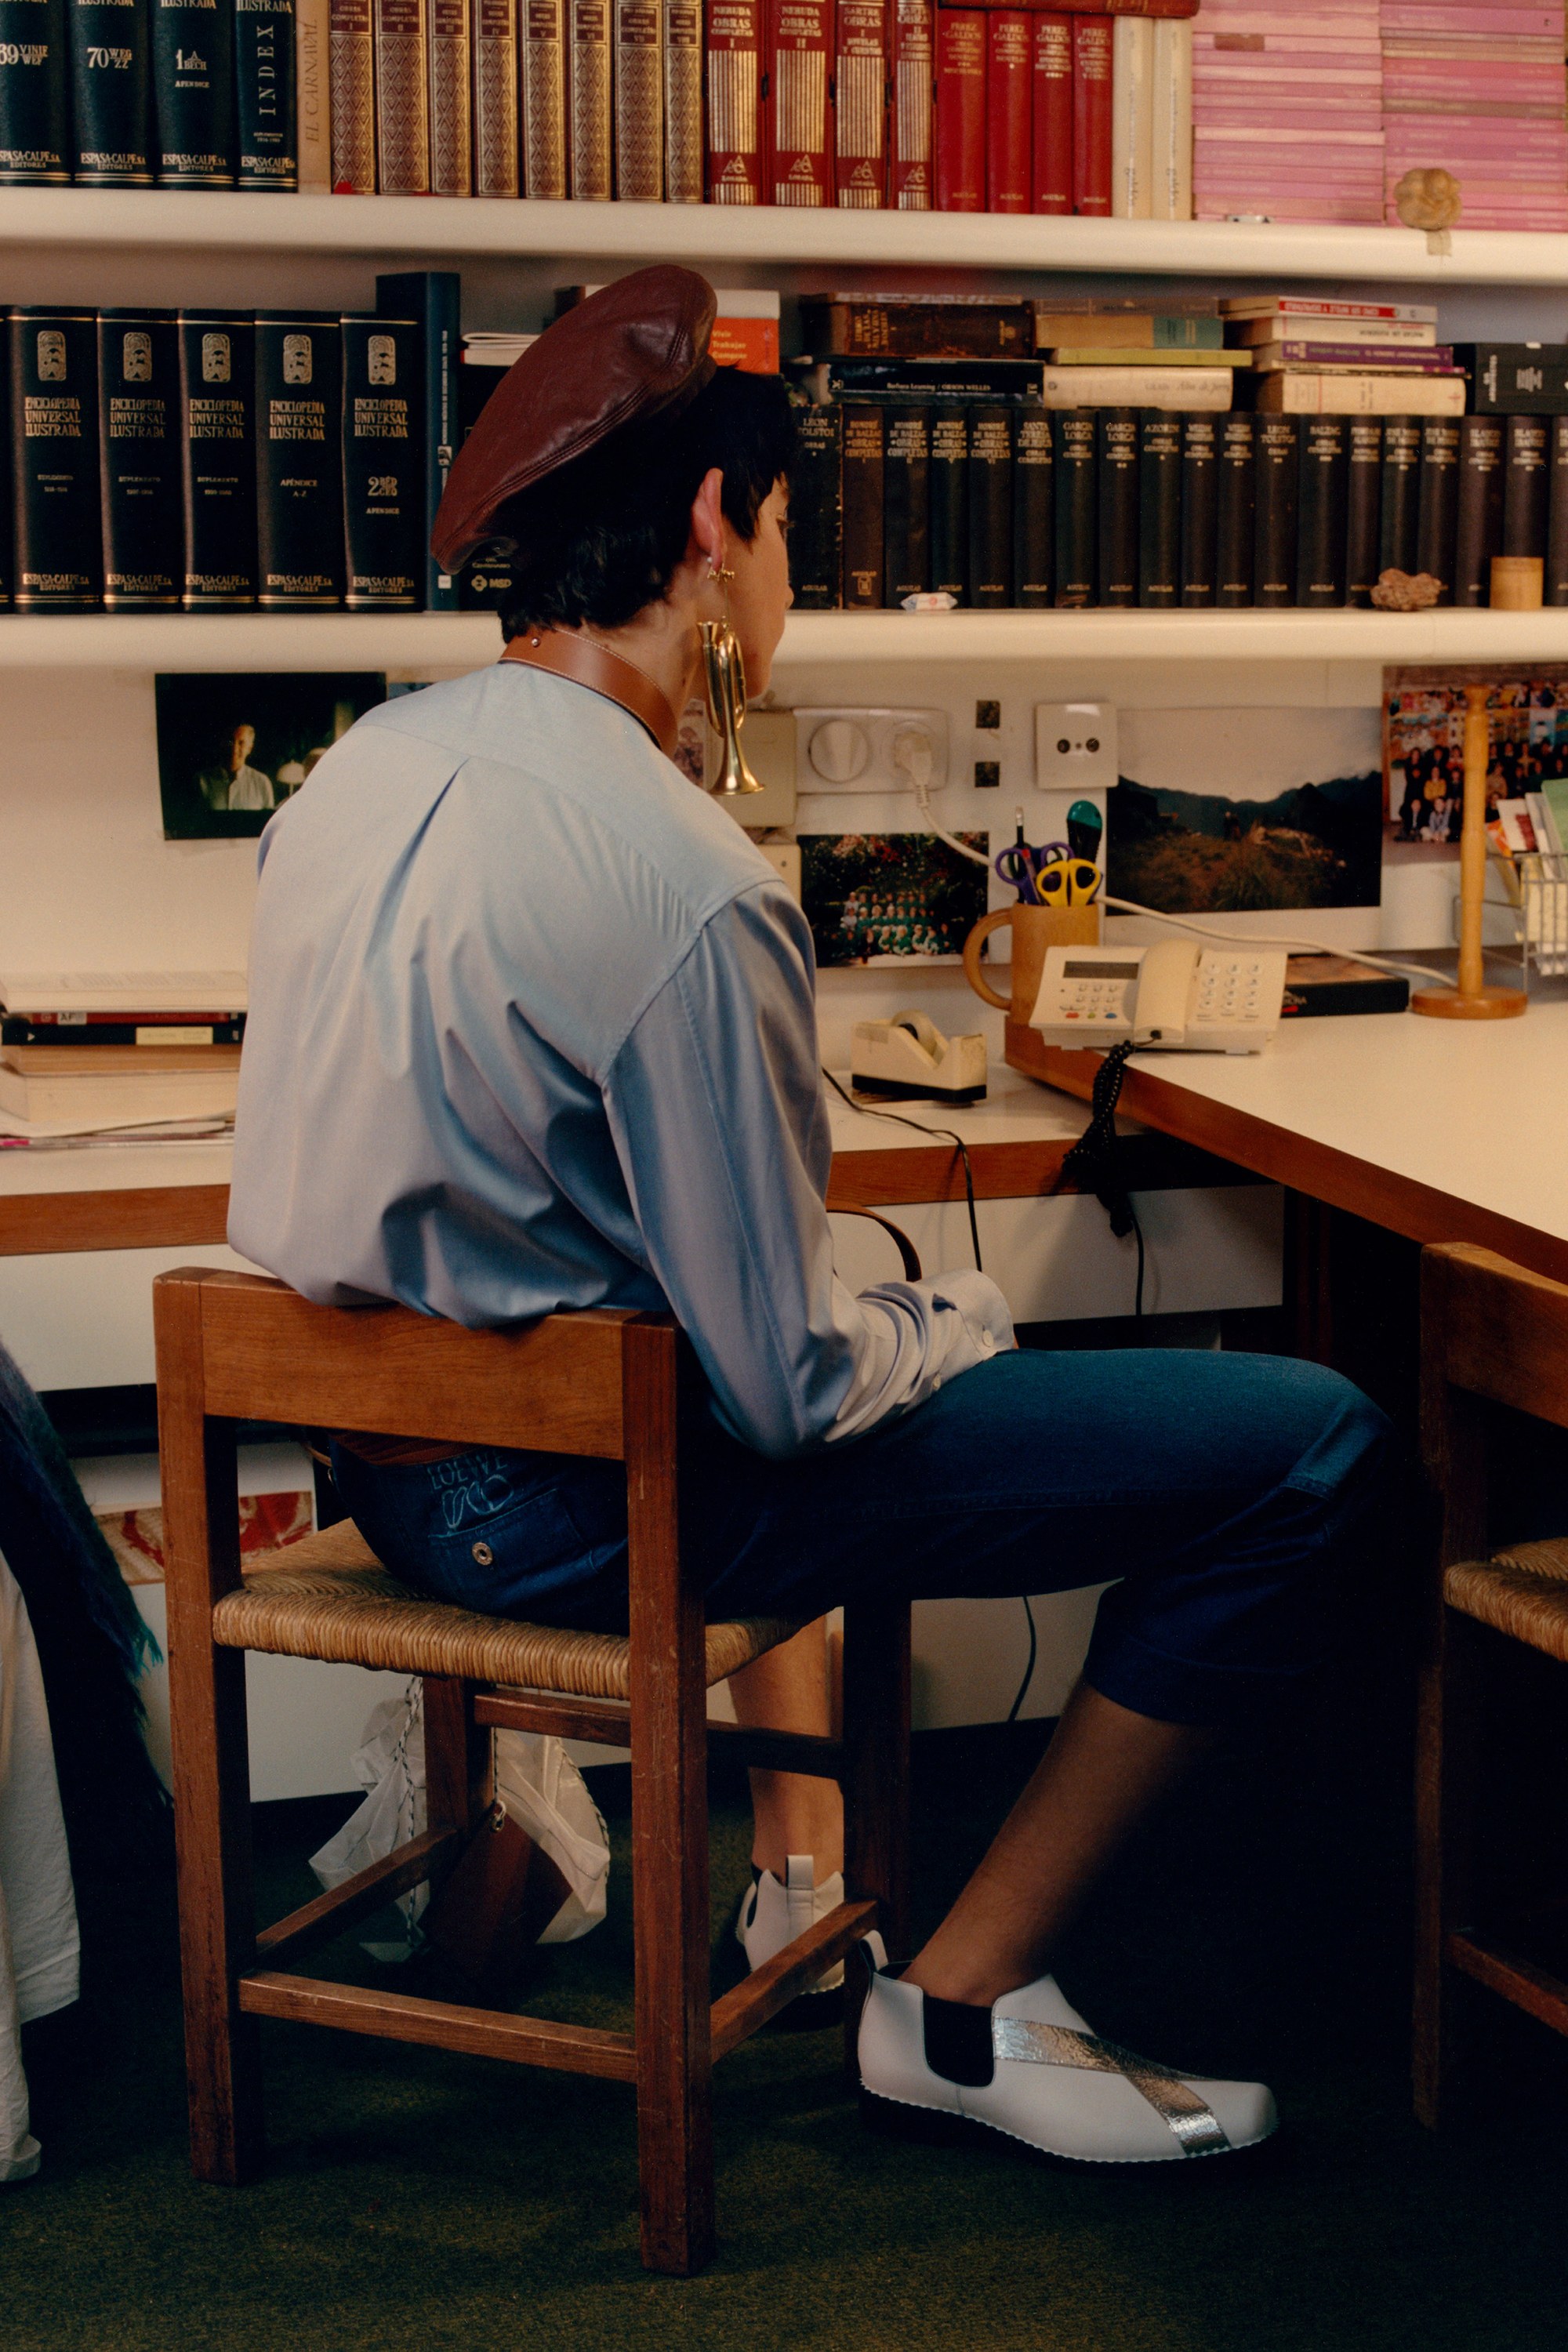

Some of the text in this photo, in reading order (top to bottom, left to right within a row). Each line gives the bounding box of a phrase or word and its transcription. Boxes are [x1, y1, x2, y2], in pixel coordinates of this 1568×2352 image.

[713, 5, 752, 16] NERUDA
[782, 5, 820, 16] NERUDA
[713, 17, 752, 28] OBRAS
[781, 17, 820, 28] OBRAS
[844, 16, 882, 27] OBRAS
[729, 38, 735, 49] I
[796, 38, 806, 49] II
[87, 47, 110, 68] 70
[114, 59, 129, 69] ZZ
[176, 49, 183, 70] 1
[256, 24, 276, 116] INDEX
[305, 122, 319, 143] EL
[25, 396, 81, 410] ENCICLOPEDIA
[111, 397, 165, 412] ENCICLOPEDIA
[190, 398, 245, 412] ENCICLOPEDIA
[270, 399, 325, 414] ENCICLOPEDIA
[354, 397, 408, 412] ENCICLOPEDIA
[25, 409, 81, 423] UNIVERSAL
[111, 412, 166, 425] UNIVERSAL
[190, 412, 245, 425] UNIVERSAL
[270, 413, 325, 427] UNIVERSAL
[354, 411, 408, 425] UNIVERSAL
[26, 423, 82, 437] ILUSTRADA
[111, 424, 165, 438] ILUSTRADA
[190, 425, 245, 439] ILUSTRADA
[270, 426, 325, 441] ILUSTRADA
[354, 423, 408, 438] ILUSTRADA
[367, 476, 379, 497] 2
[488, 577, 513, 589] MSD
[427, 1453, 508, 1490] LOEWE
